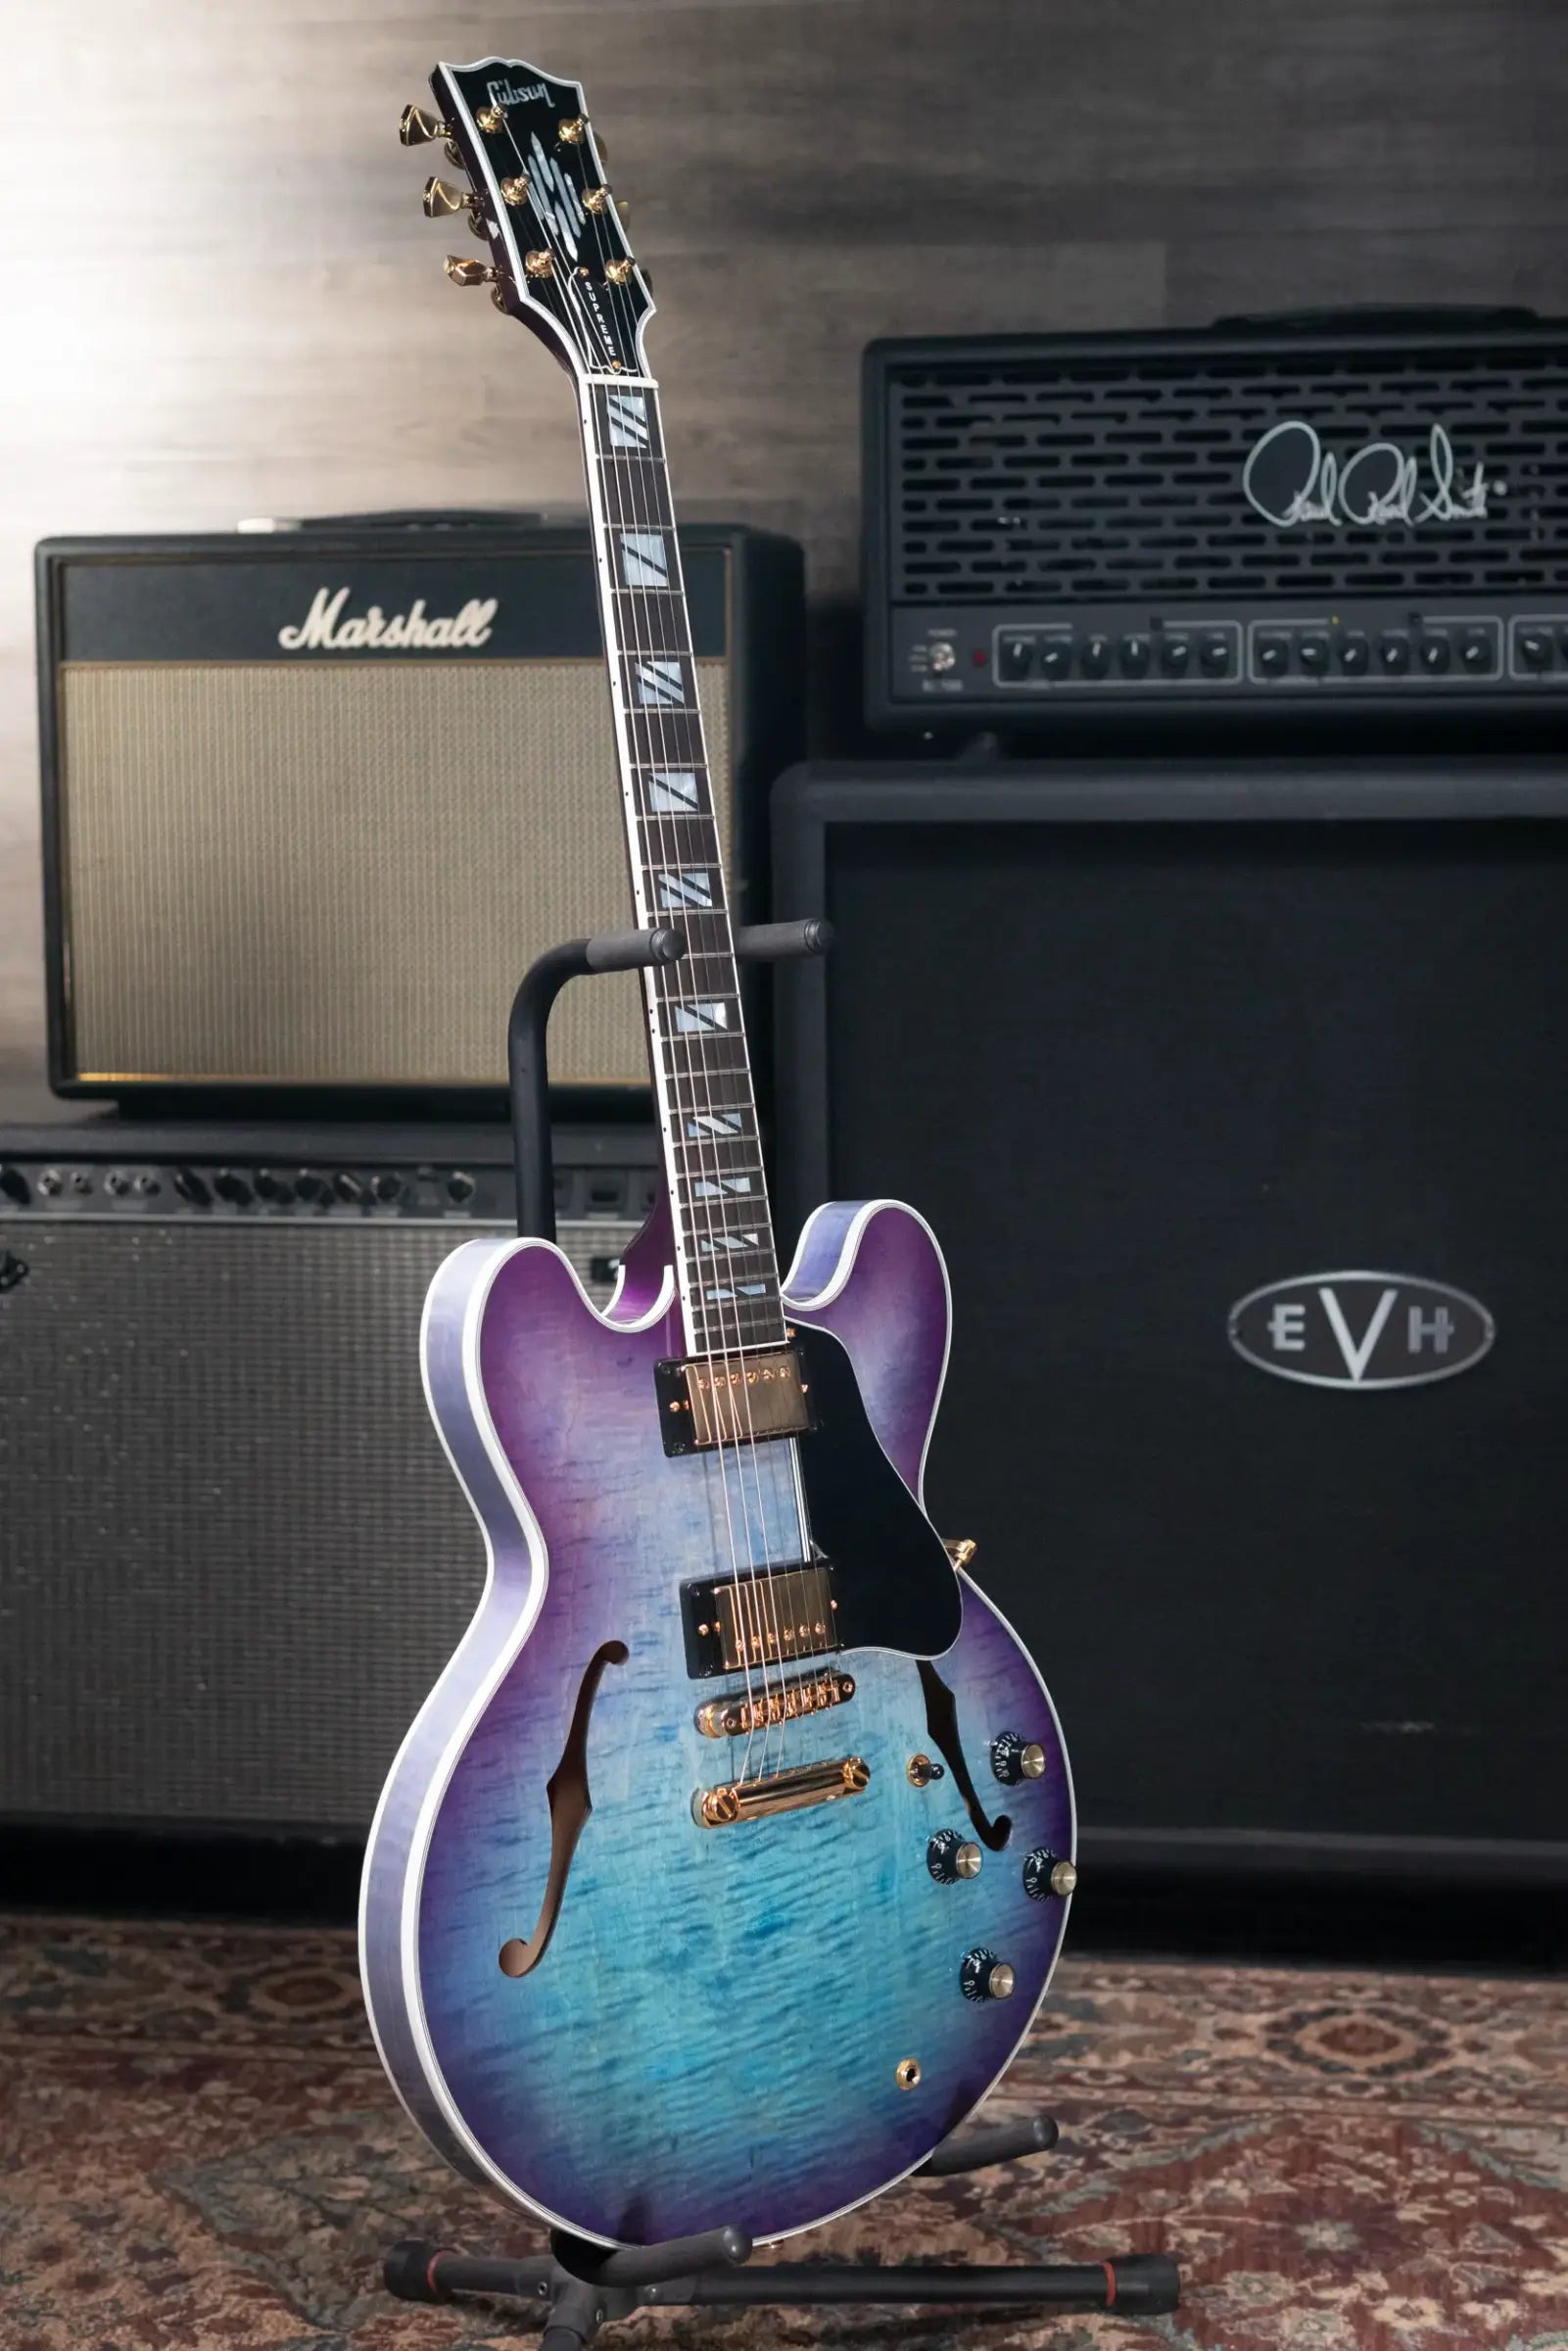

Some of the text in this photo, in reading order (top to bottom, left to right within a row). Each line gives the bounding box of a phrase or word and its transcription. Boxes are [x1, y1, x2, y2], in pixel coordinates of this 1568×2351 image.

[486, 78, 556, 109] Gibson
[585, 281, 617, 357] SUPREME
[278, 587, 499, 649] Marshall
[1267, 1287, 1454, 1382] EVH
